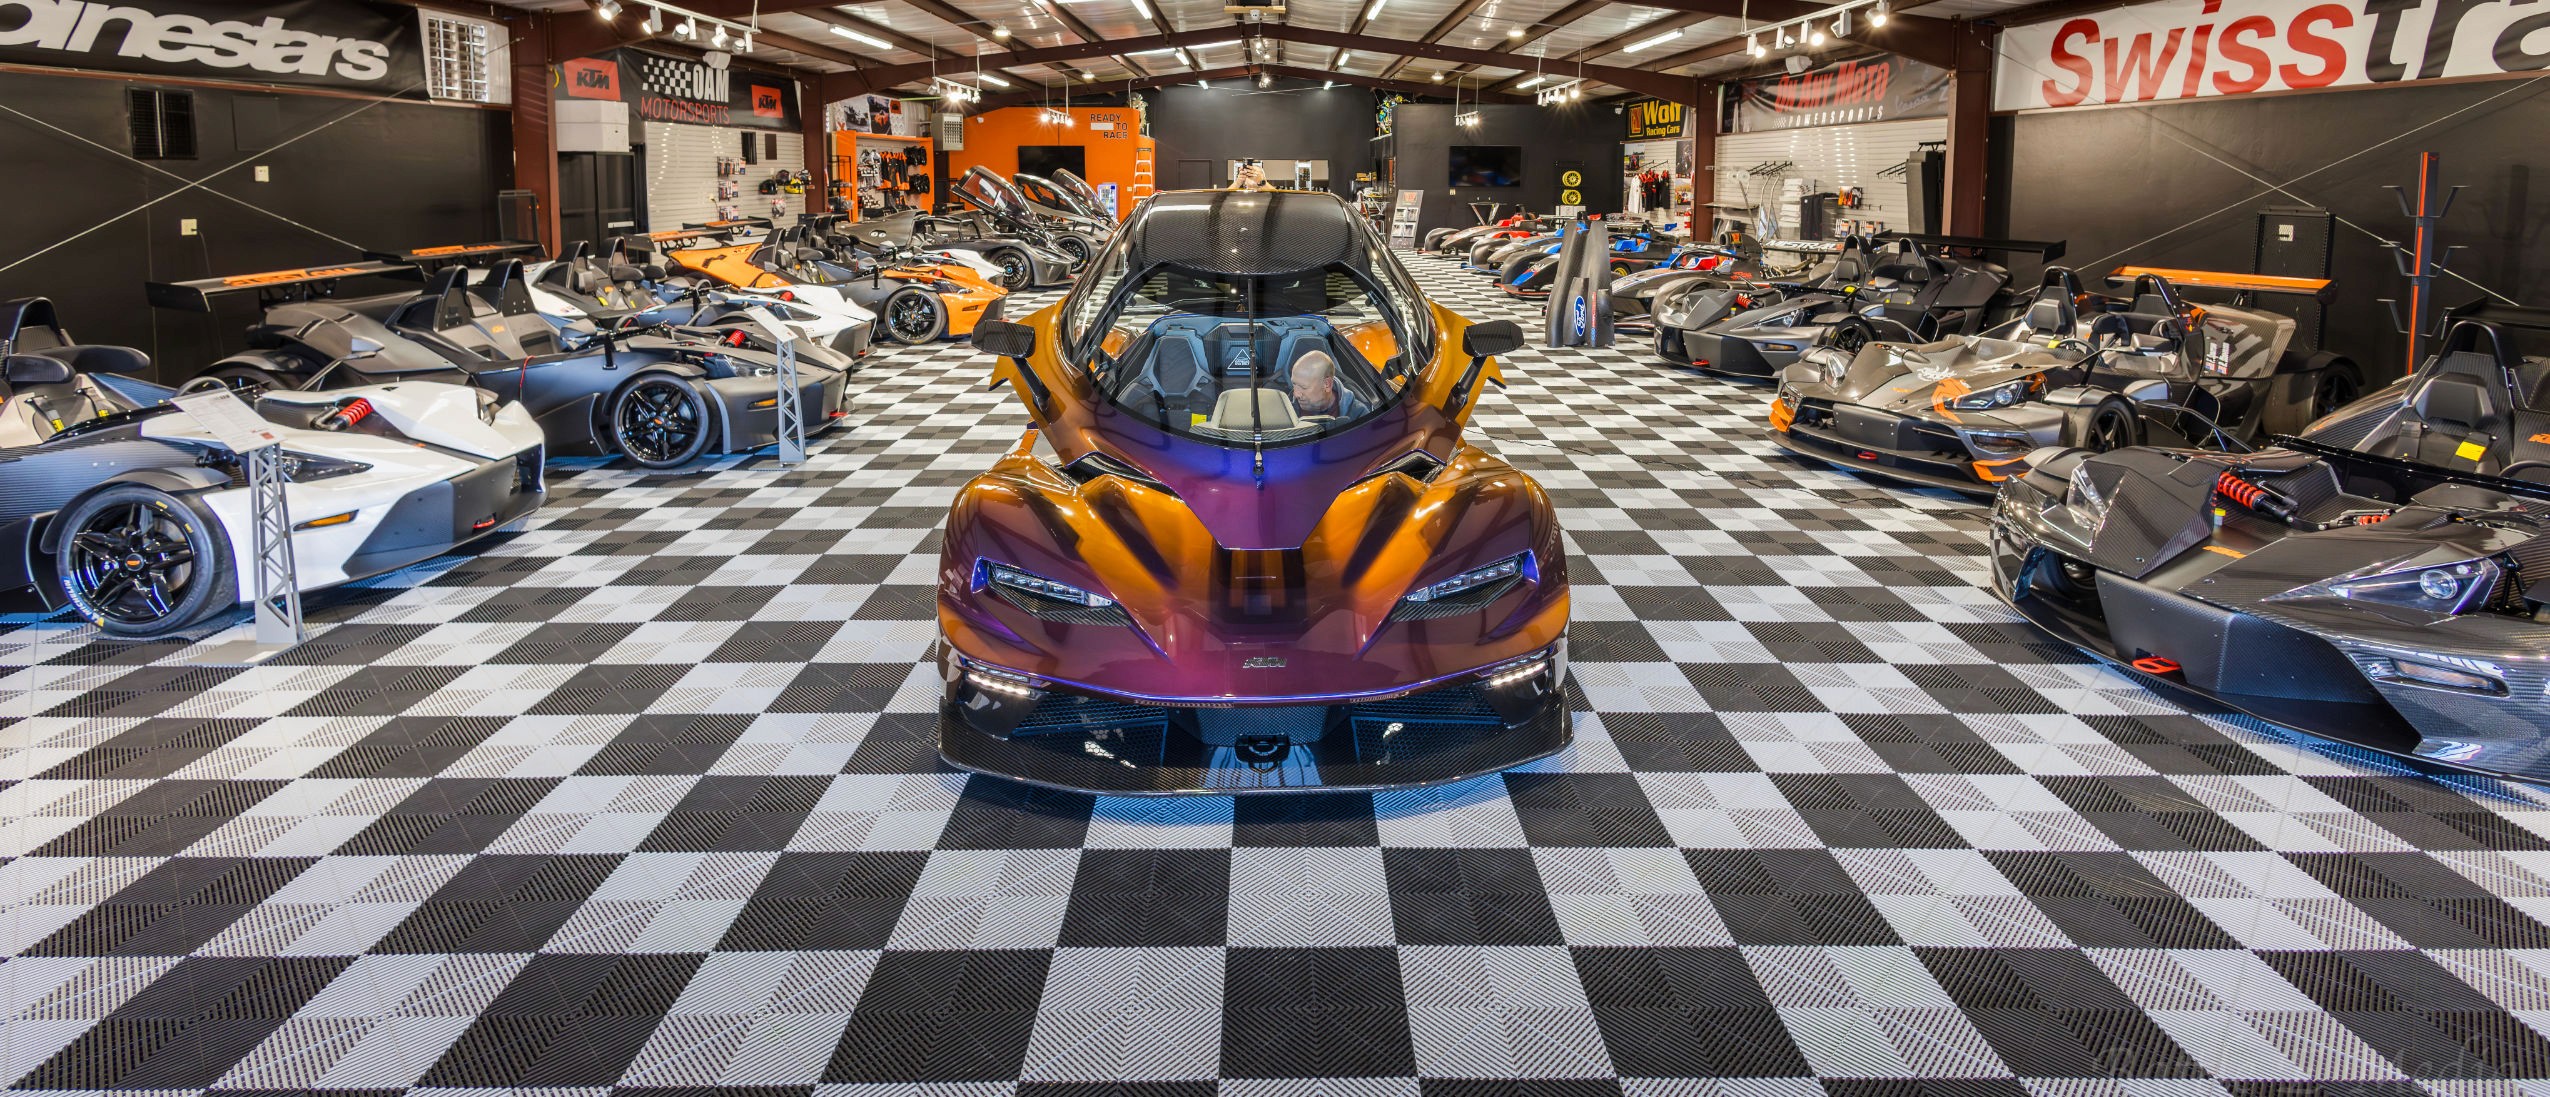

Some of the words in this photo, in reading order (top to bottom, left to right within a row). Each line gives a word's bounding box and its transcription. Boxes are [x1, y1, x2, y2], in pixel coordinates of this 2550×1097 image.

[577, 68, 610, 91] KTM
[693, 63, 730, 103] OAM
[1799, 70, 1834, 110] ANY
[1833, 61, 1890, 107] MOTO
[641, 97, 730, 124] MOTORSPORTS
[758, 94, 777, 110] KTM
[1090, 113, 1121, 122] READY
[1788, 105, 1884, 127] POWERSPORTS
[1103, 131, 1128, 139] RACE
[1115, 122, 1128, 130] TO
[1646, 126, 1666, 137] Racing
[1666, 125, 1681, 134] Cars
